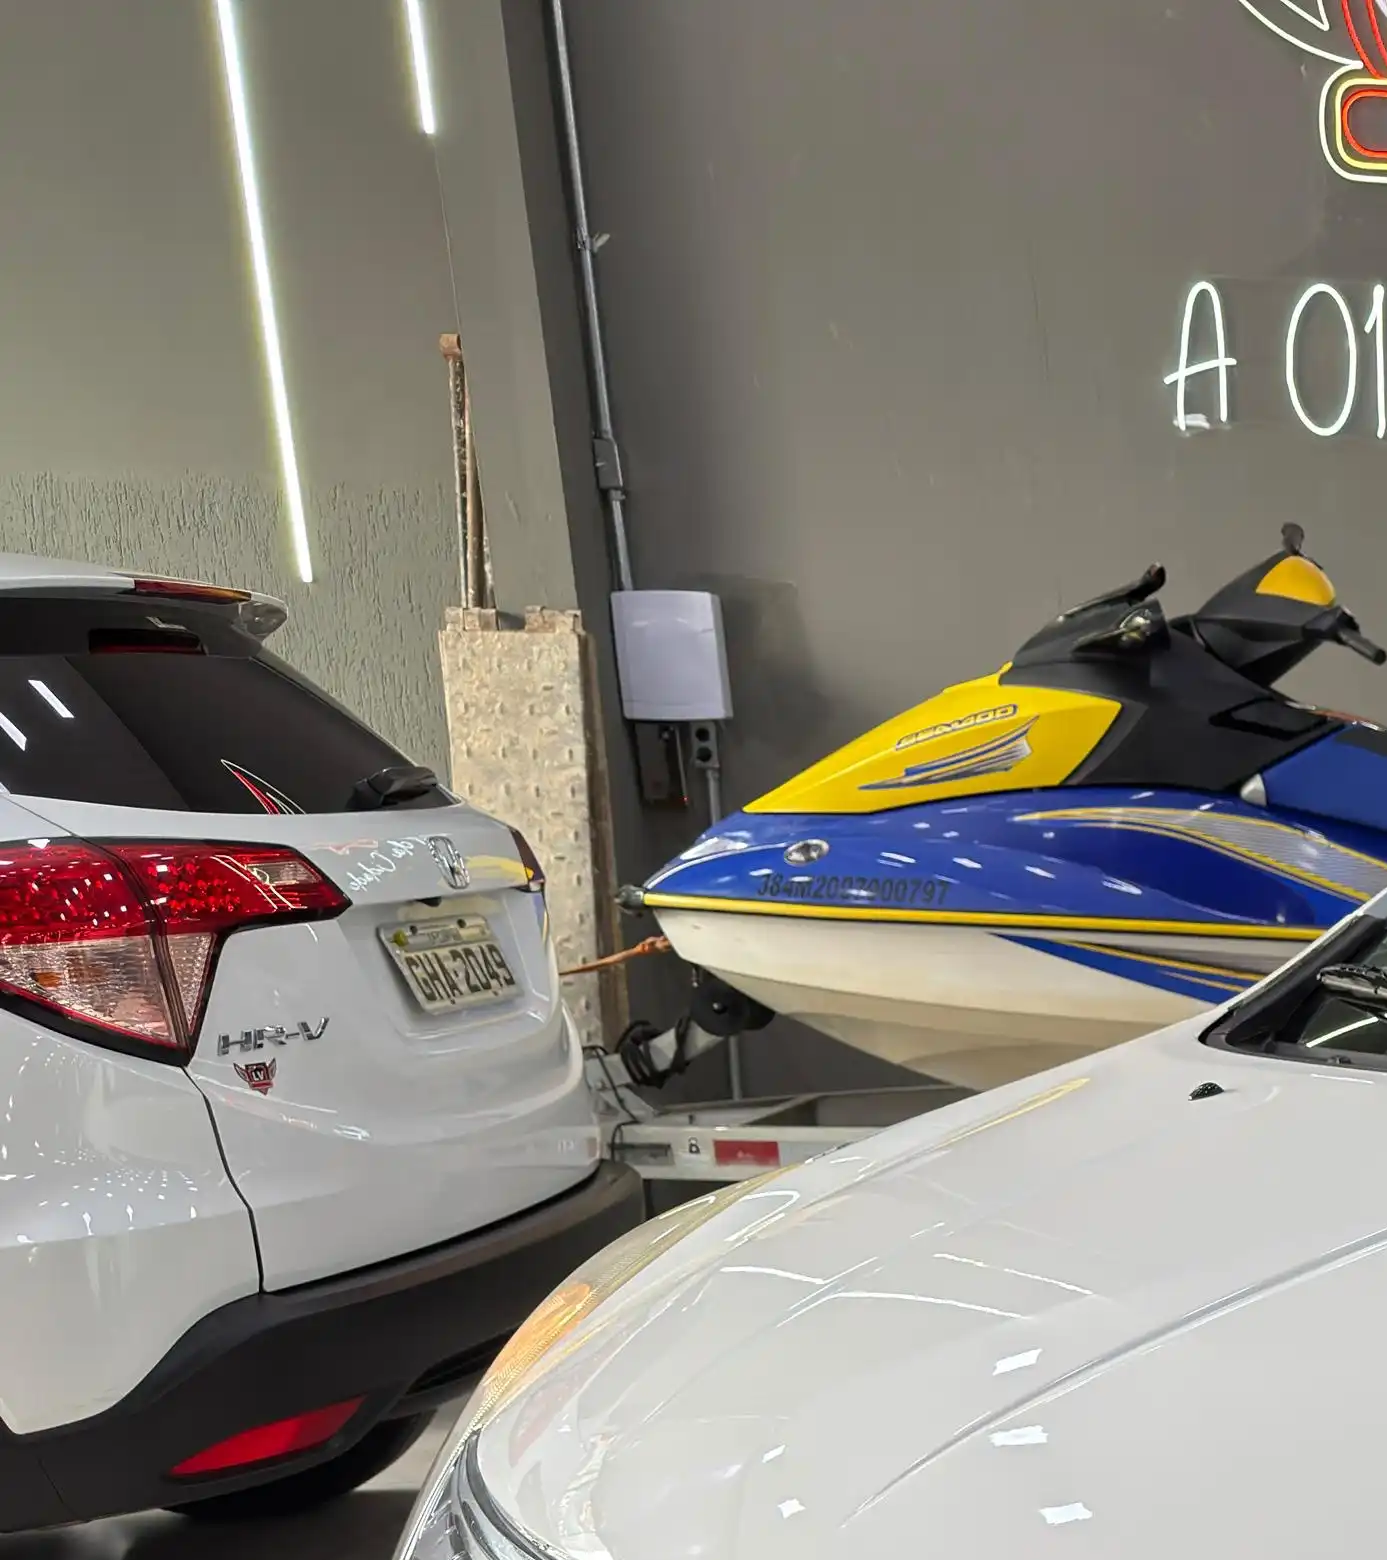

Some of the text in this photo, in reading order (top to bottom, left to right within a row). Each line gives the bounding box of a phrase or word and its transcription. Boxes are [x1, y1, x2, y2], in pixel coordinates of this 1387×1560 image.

[1163, 281, 1237, 431] A
[1285, 283, 1385, 438] 01
[217, 1017, 330, 1057] HR-V
